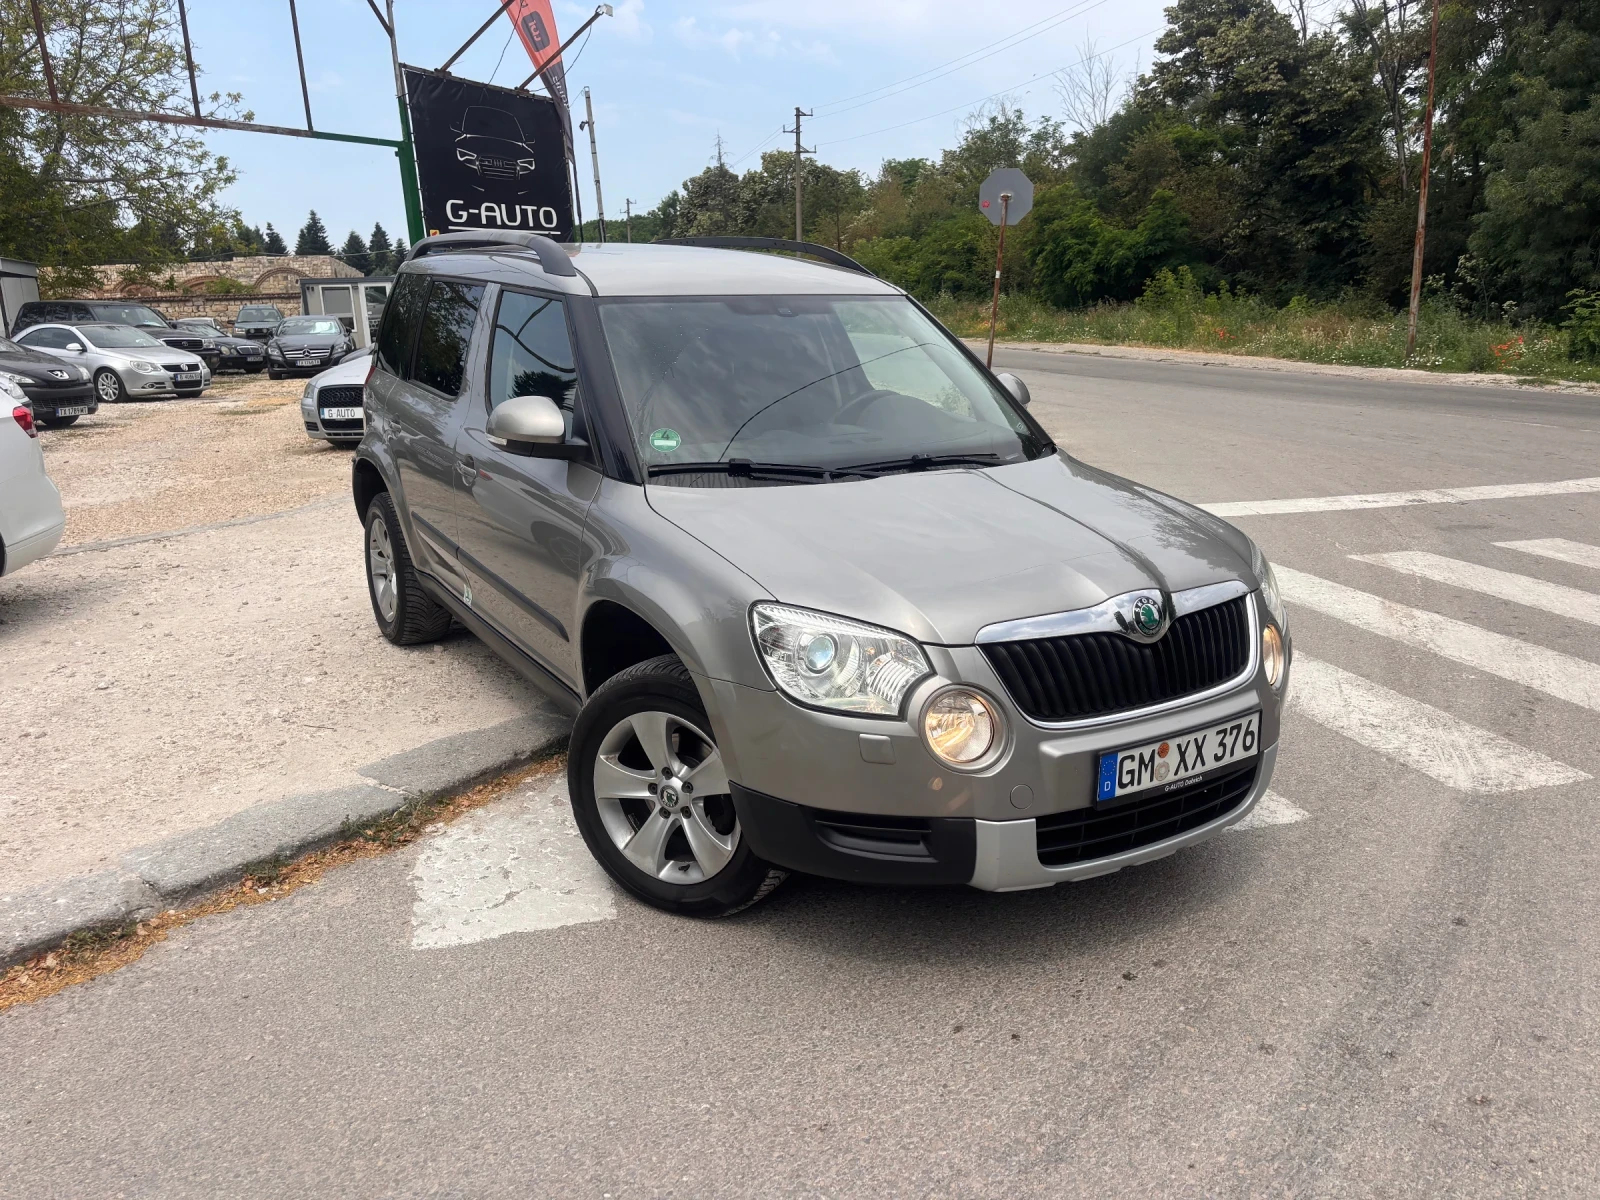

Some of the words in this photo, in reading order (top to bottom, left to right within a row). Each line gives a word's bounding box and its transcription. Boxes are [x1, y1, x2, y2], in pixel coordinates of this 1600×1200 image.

[445, 199, 558, 228] G-AUTO
[661, 430, 670, 440] 4
[1117, 748, 1156, 789] GM
[1173, 733, 1208, 776] XX
[1213, 719, 1255, 763] 376
[1104, 781, 1111, 791] D
[1164, 780, 1184, 791] G-AUTO
